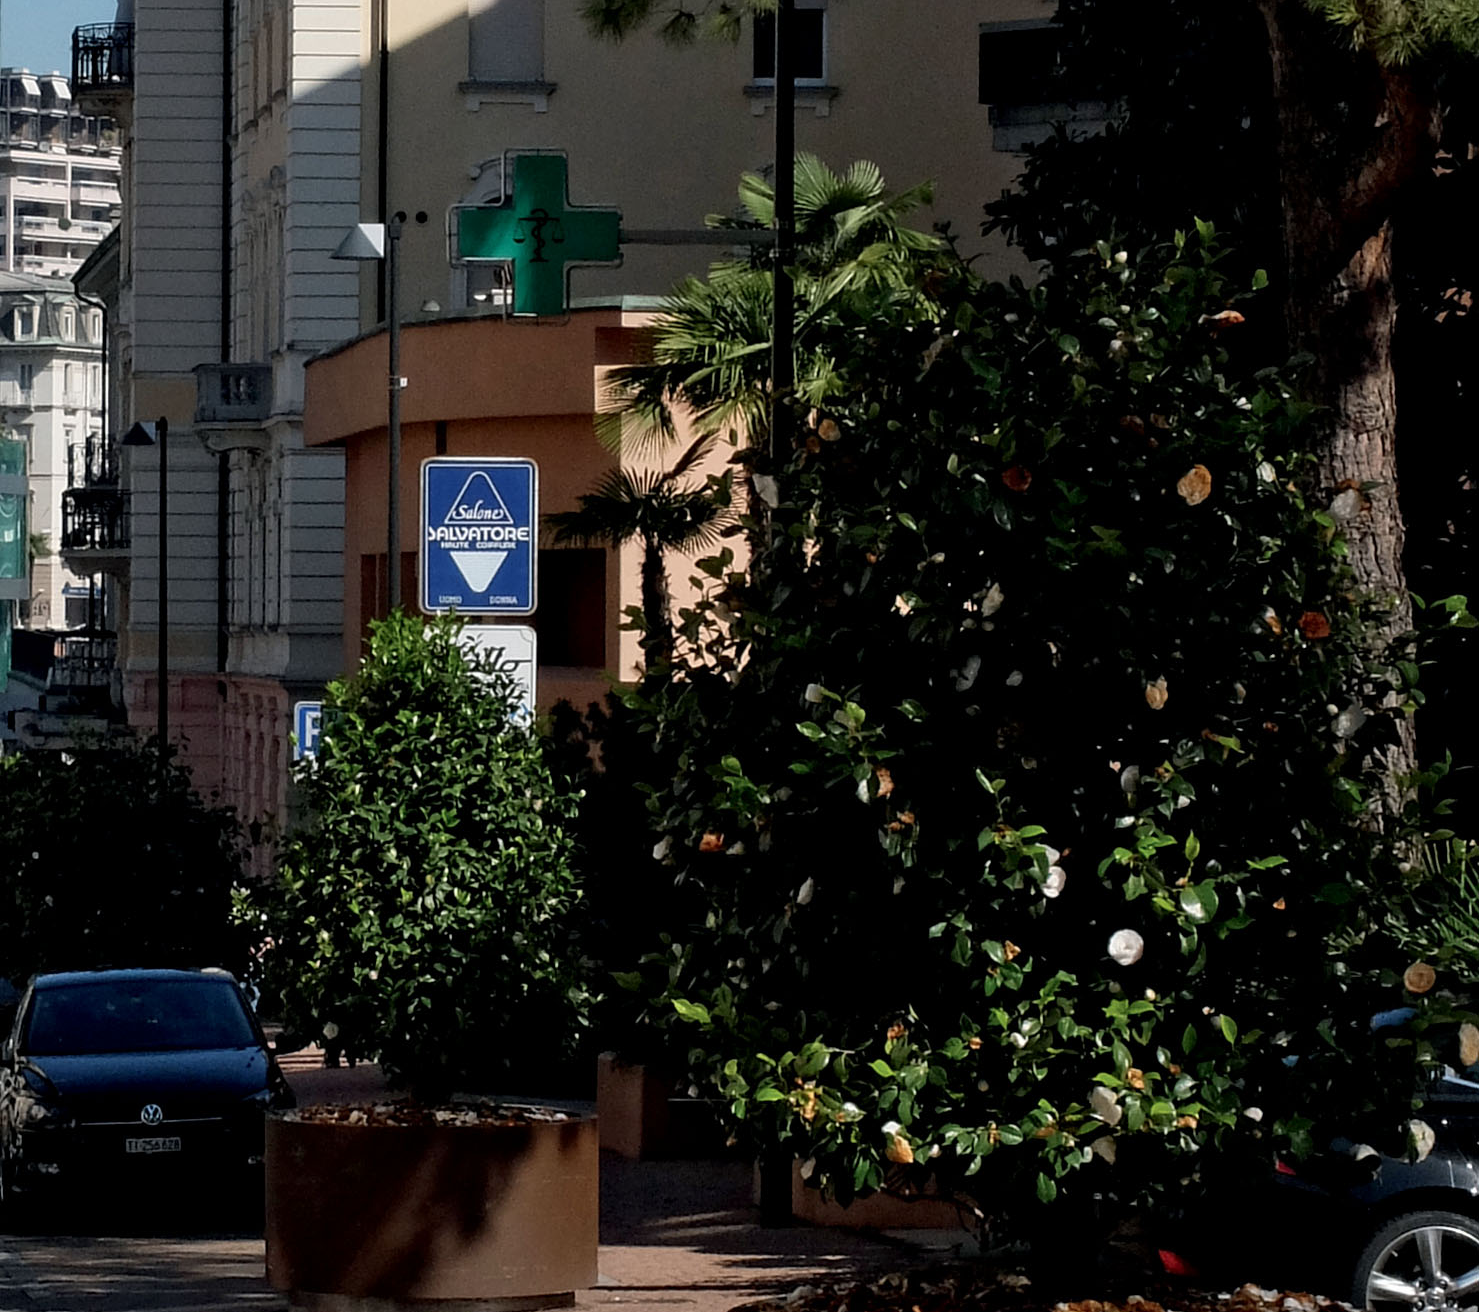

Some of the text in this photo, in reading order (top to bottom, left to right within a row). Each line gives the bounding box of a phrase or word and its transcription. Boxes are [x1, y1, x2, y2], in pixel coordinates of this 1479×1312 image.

[452, 500, 504, 520] Salone
[428, 526, 530, 541] SALVATORE
[439, 595, 462, 604] UOMO
